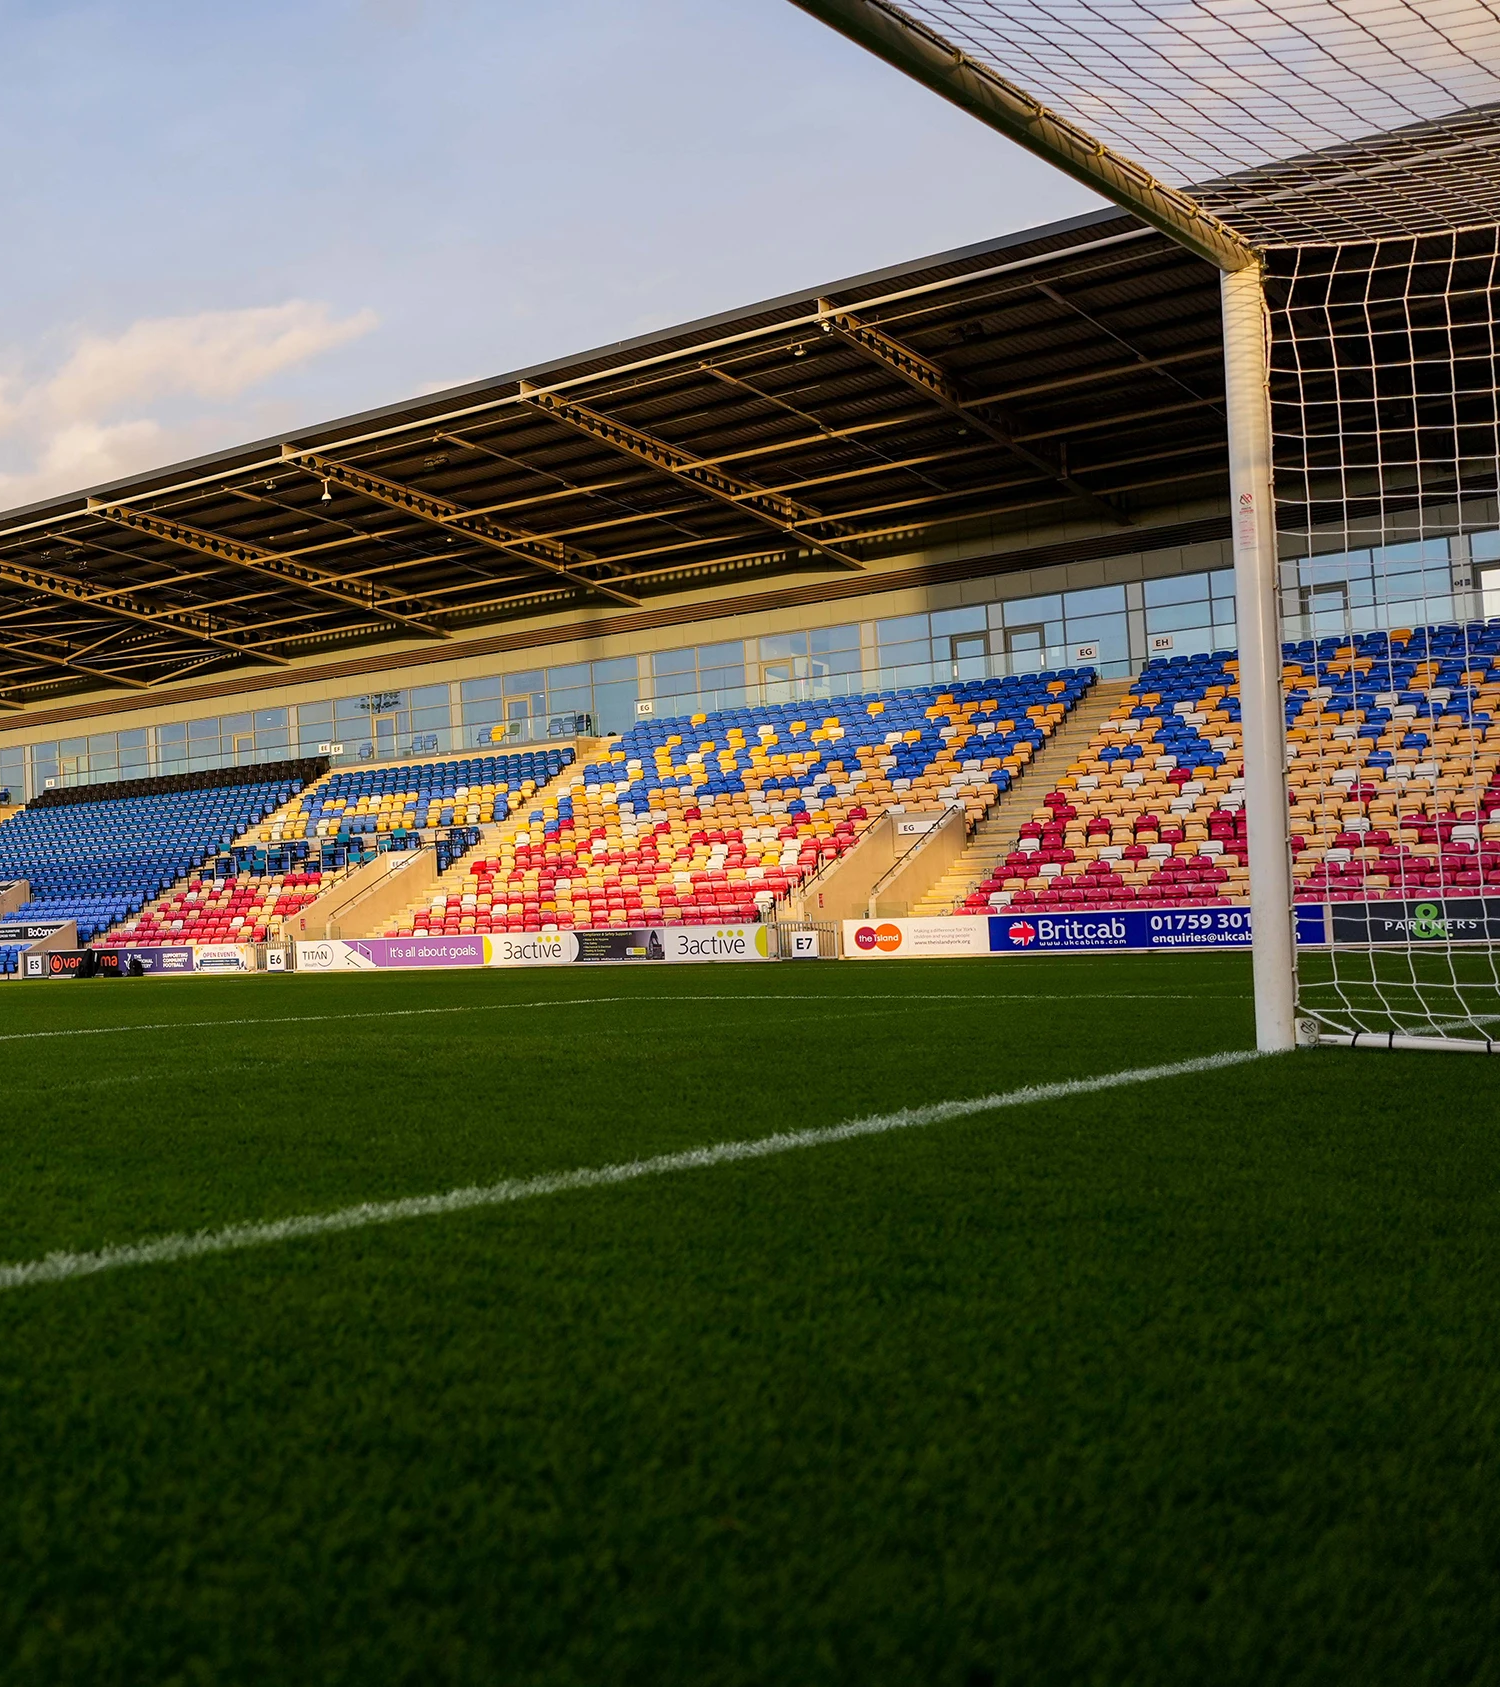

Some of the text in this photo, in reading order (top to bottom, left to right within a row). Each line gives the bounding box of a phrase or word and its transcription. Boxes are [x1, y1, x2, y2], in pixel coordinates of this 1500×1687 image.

[1155, 638, 1169, 647] EH
[1079, 648, 1092, 656] EG
[903, 824, 915, 832] EG
[1150, 914, 1213, 931] 01759
[1384, 920, 1477, 931] PARTNERS
[1038, 917, 1126, 940] Britcab
[1039, 939, 1127, 947] www.ukcabins.com
[1152, 931, 1253, 945] enquiries@ukcab
[677, 935, 746, 955] 3active
[796, 938, 813, 950] E7
[302, 950, 328, 960] TITAN
[389, 944, 478, 959] It's all about goals.
[503, 941, 562, 960] 3active
[270, 955, 282, 964] E6
